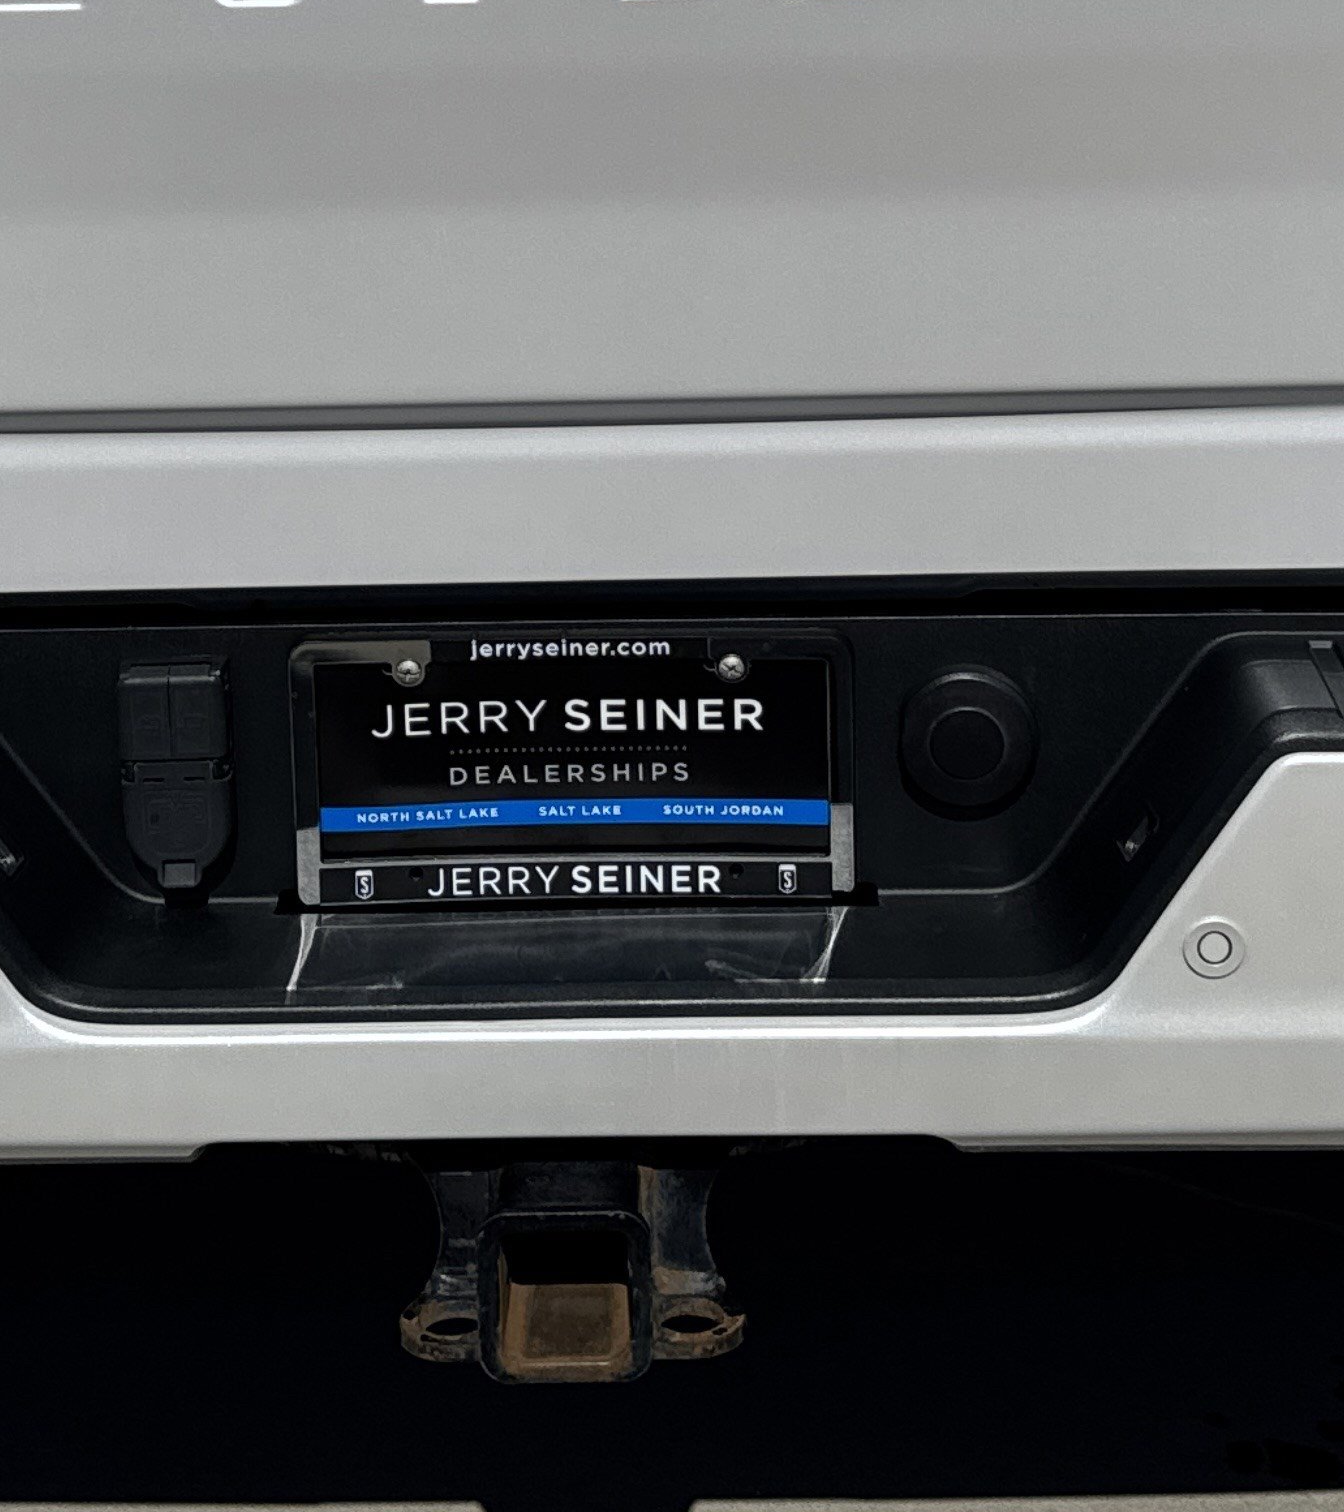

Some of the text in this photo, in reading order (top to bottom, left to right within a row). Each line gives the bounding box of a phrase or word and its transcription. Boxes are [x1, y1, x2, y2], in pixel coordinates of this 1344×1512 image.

[469, 638, 671, 661] jerryseiner.com
[371, 698, 765, 738] JERRY SEINER
[449, 761, 690, 786] DEALERSHIPS
[357, 807, 499, 823] NORTH SALT LAKE
[538, 805, 621, 817] SALT LAKE
[663, 805, 784, 816] SOUTH JORDAN
[427, 865, 721, 897] JERRY SEINER
